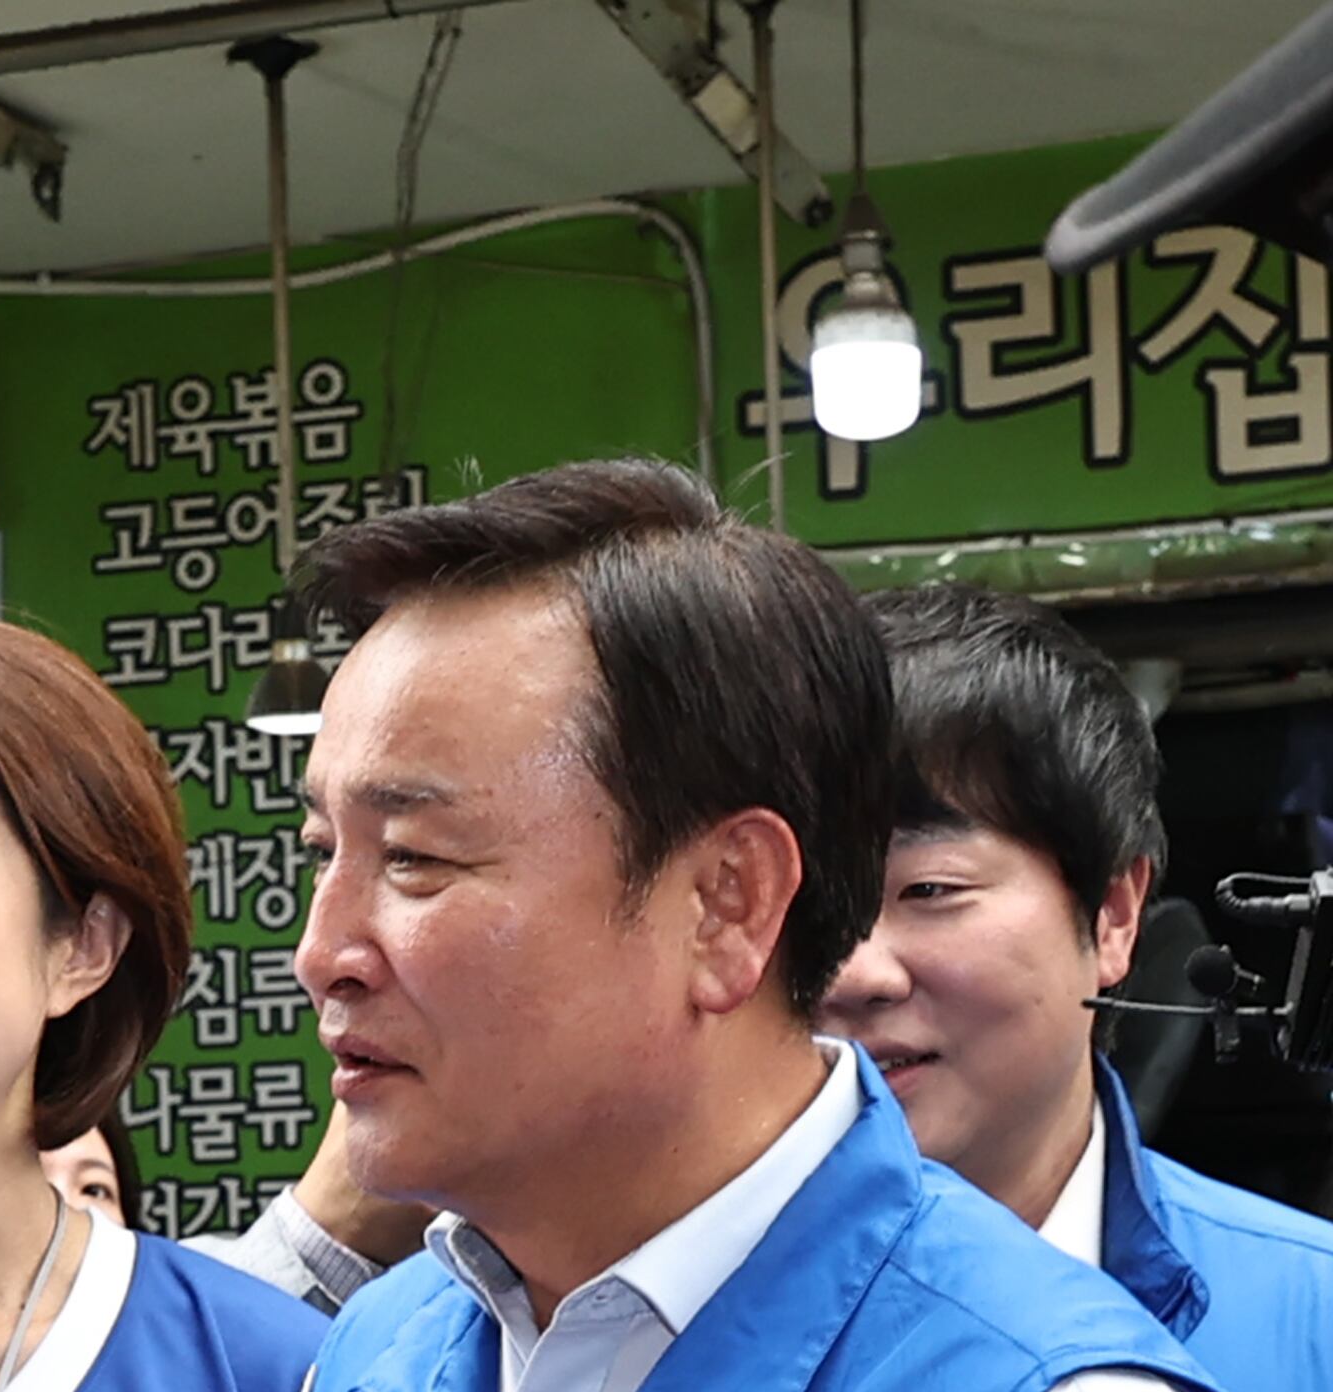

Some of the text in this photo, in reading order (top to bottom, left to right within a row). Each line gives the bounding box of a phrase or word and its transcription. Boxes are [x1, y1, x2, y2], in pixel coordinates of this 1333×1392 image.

[87, 362, 361, 474] 제육볶음
[151, 718, 305, 812] 자반
[171, 949, 309, 1047] 침류
[119, 1063, 315, 1163] 나물류
